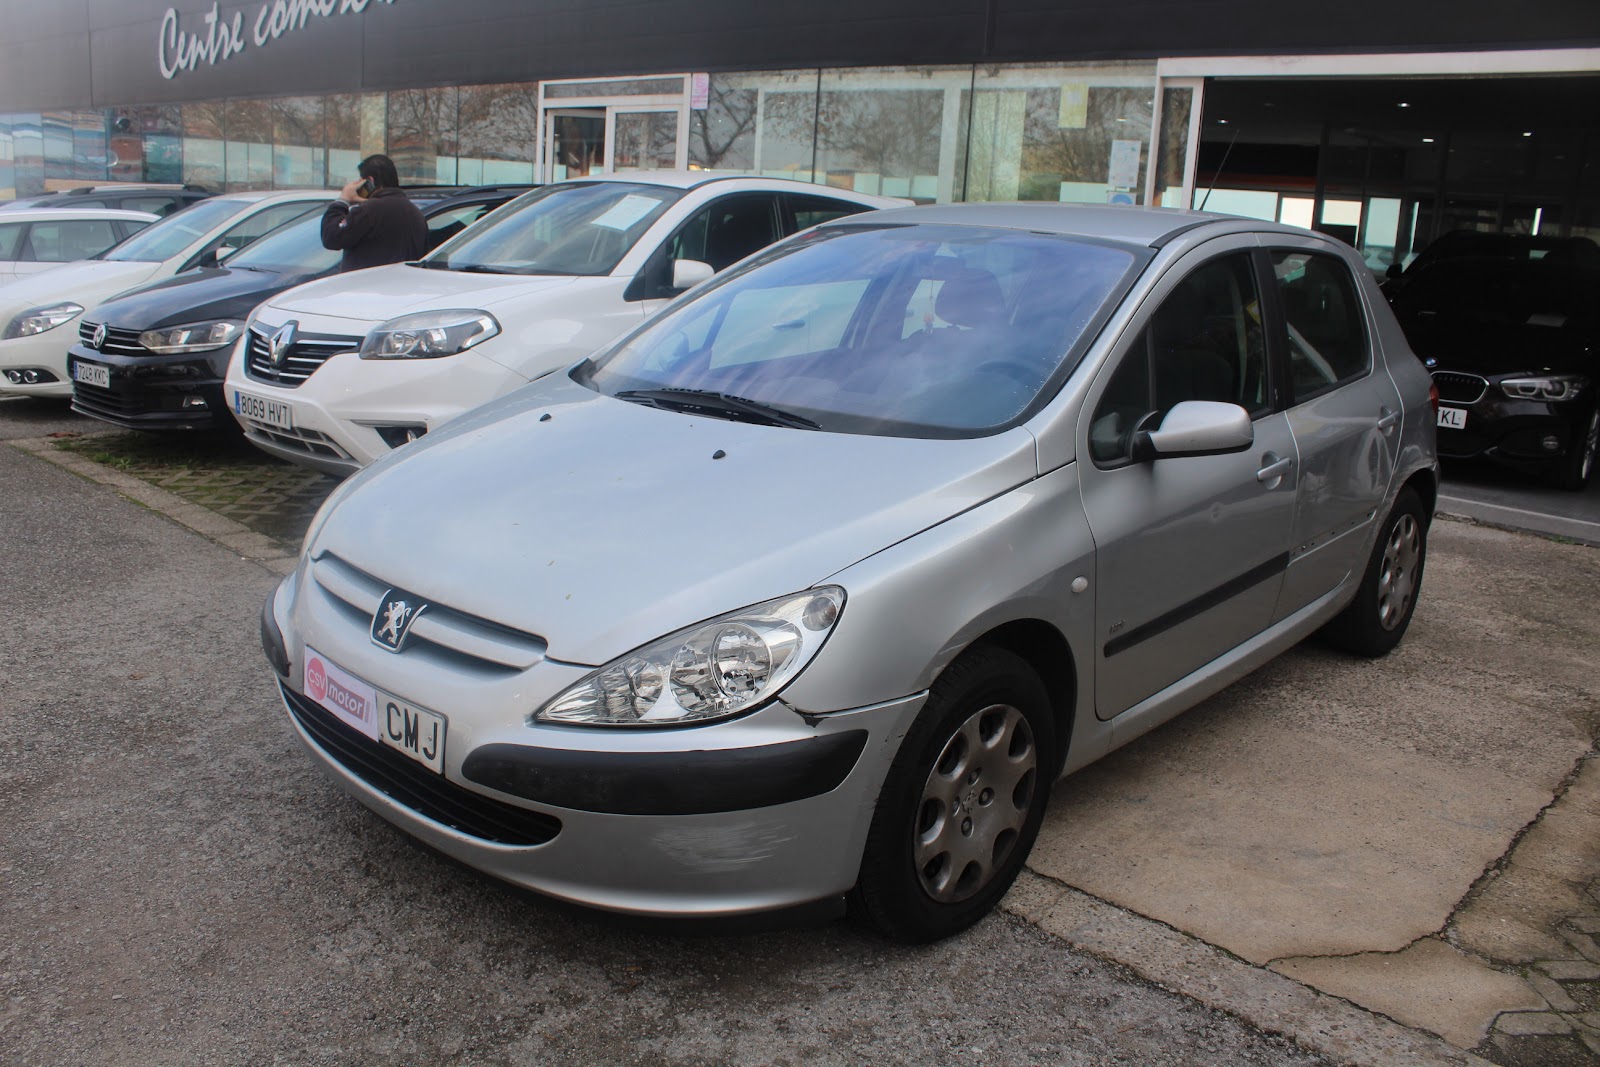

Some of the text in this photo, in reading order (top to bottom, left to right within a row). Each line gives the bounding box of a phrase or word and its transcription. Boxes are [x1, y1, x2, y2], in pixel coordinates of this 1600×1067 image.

[159, 2, 244, 79] Centre
[78, 365, 93, 381] 7248
[241, 396, 287, 425] 8069 HVT
[1437, 409, 1460, 426] KL
[308, 669, 363, 714] CSV motor
[387, 702, 438, 760] CMJ
